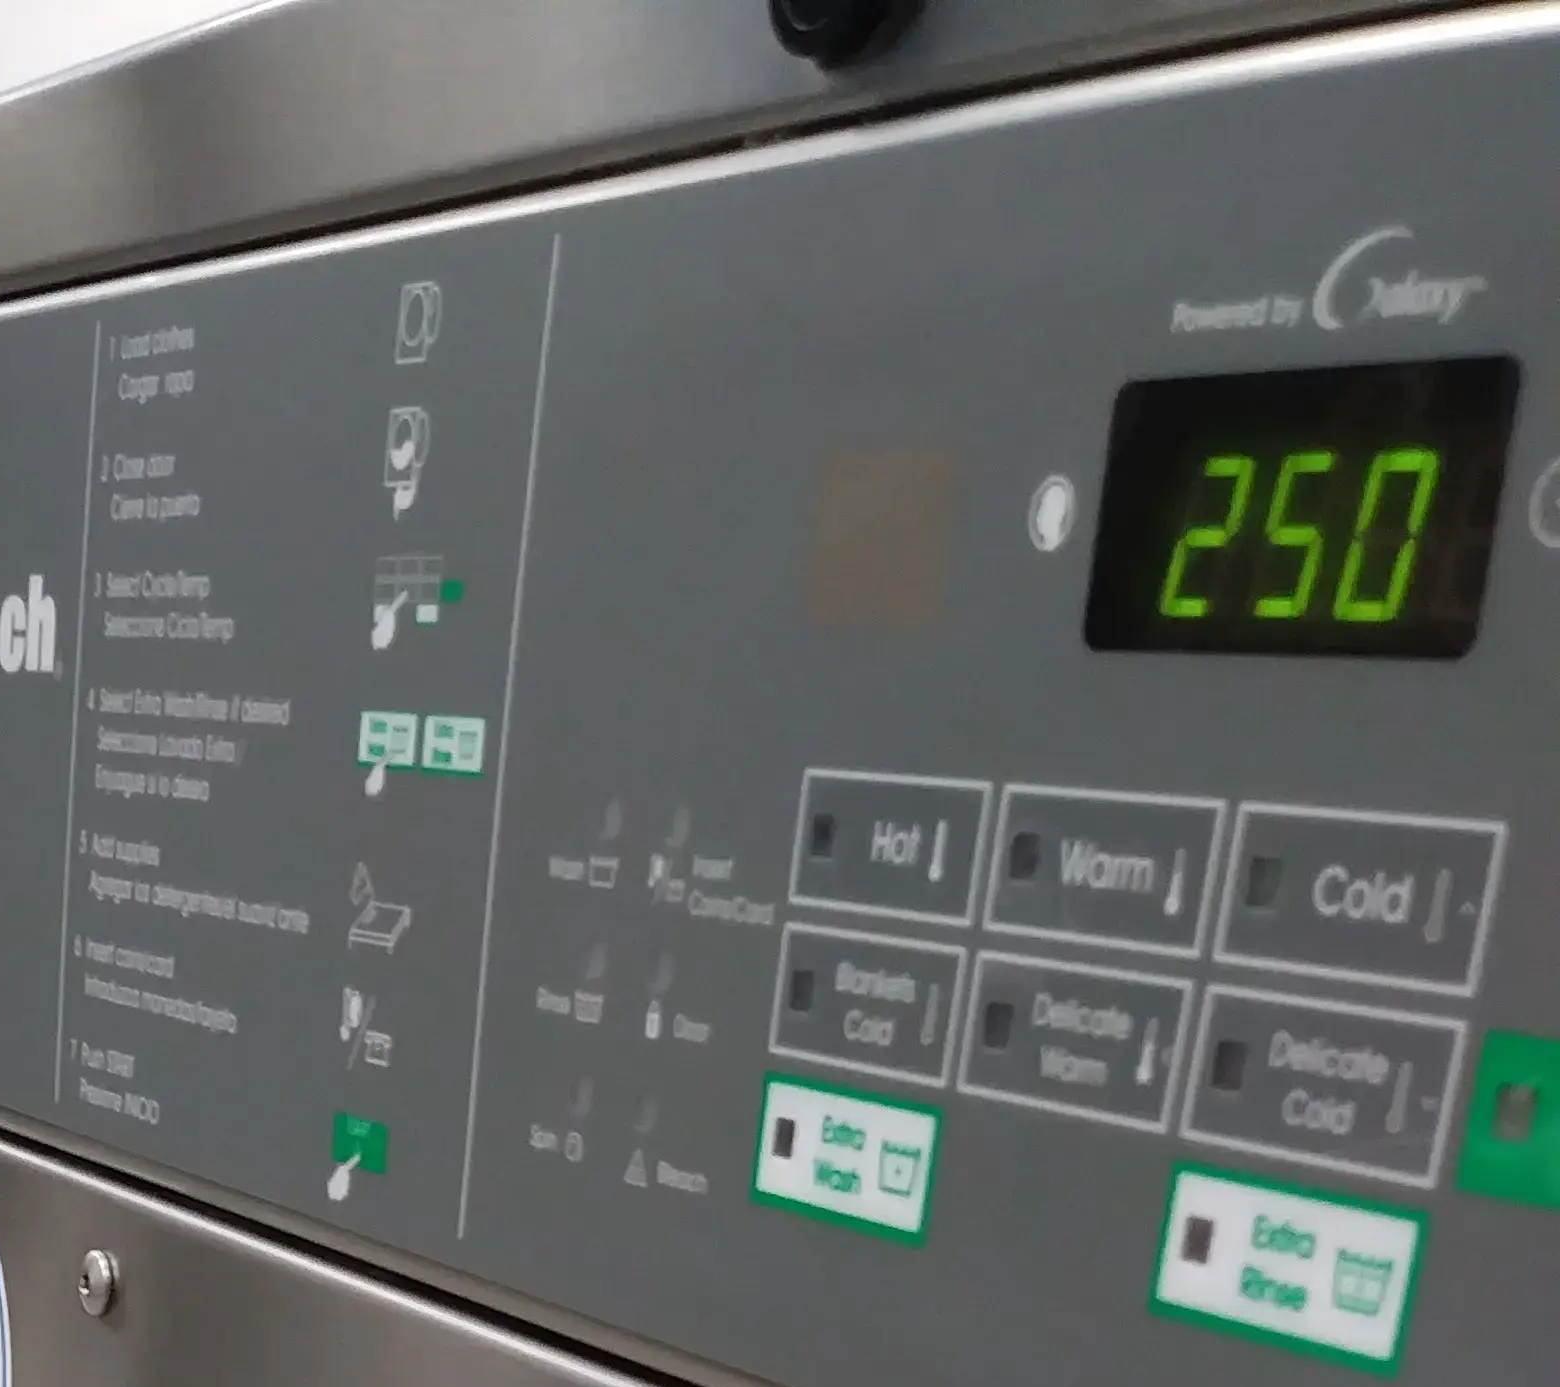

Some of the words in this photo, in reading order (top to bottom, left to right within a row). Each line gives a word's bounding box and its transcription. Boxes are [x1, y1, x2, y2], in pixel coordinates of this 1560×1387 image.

[1160, 448, 1438, 620] 250
[870, 819, 922, 864] Hot
[1311, 861, 1417, 925] Cold
